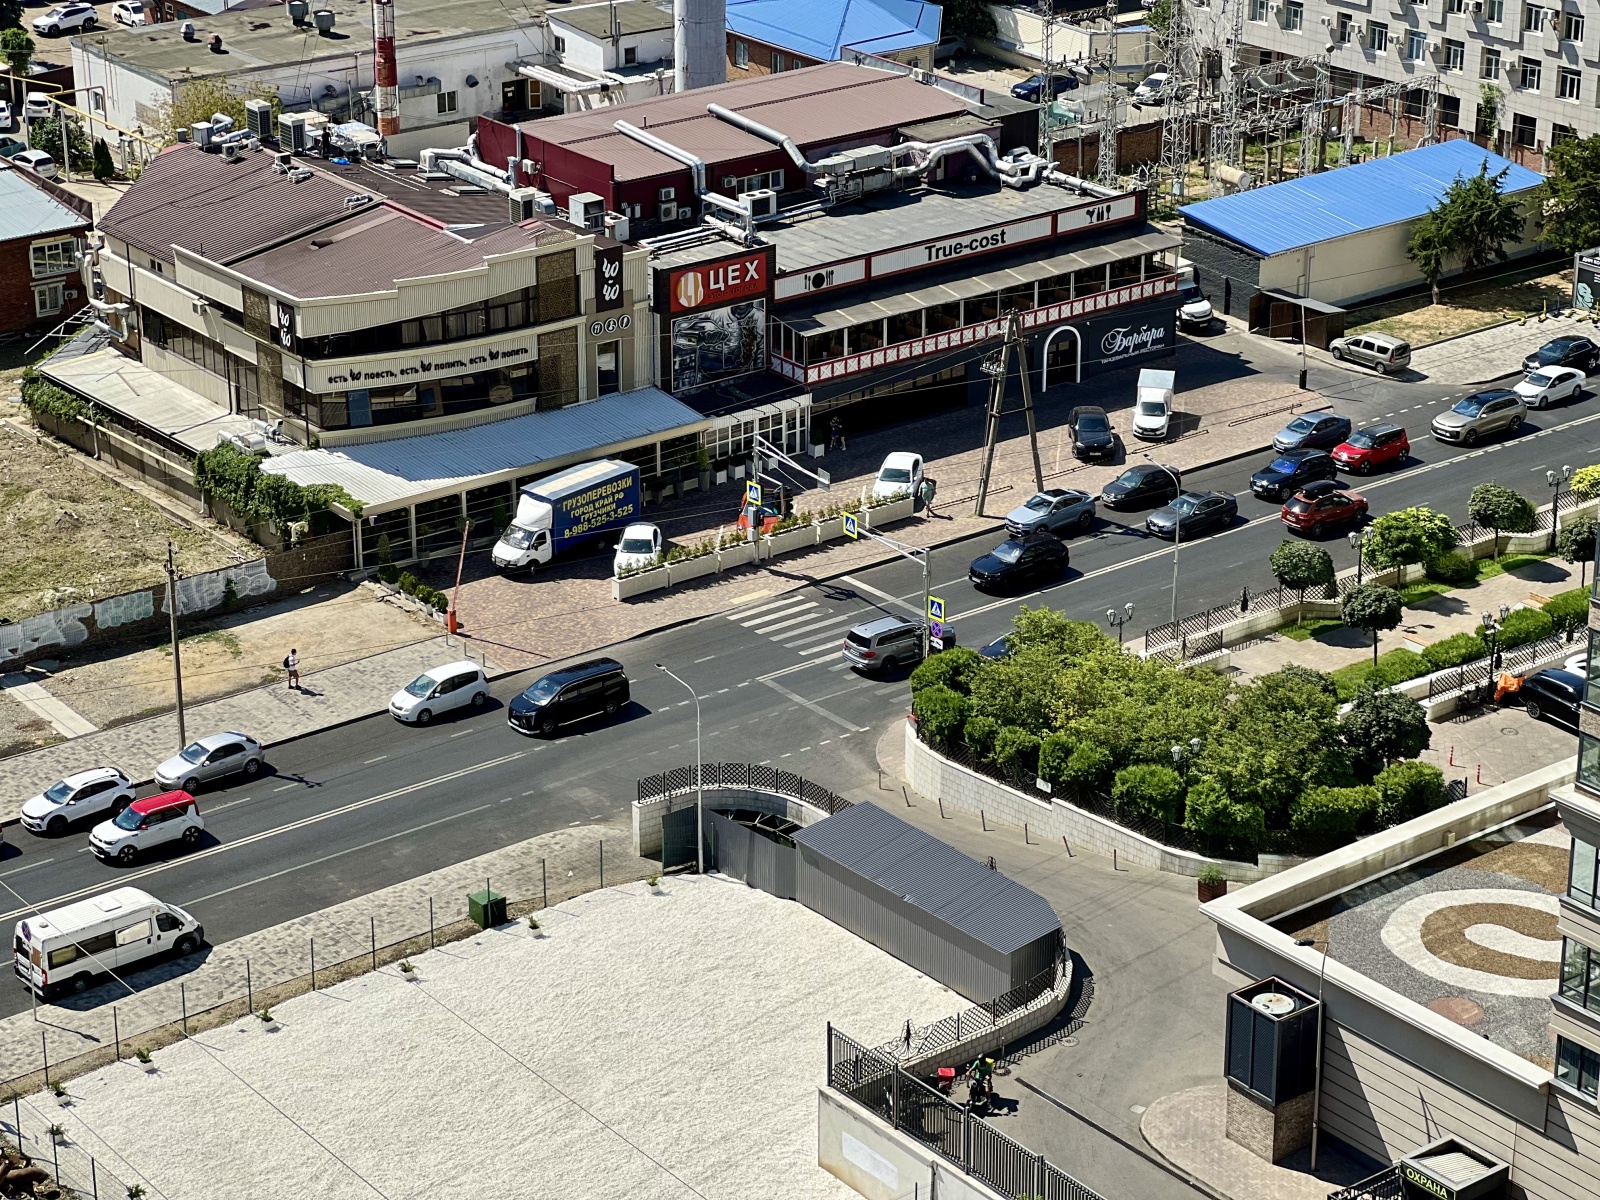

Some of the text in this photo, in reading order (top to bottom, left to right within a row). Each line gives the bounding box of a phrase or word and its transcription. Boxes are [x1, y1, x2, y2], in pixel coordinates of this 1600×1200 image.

[924, 229, 1007, 261] True-cost
[709, 260, 760, 291] ЦЕХ
[708, 290, 729, 300] ЭТОГО
[1101, 324, 1165, 354] Барбара
[328, 374, 348, 384] есть
[364, 370, 397, 381] поесть,
[400, 366, 420, 377] есть
[434, 360, 467, 371] попить,
[469, 355, 488, 365] есть
[501, 347, 529, 359] попеть
[562, 476, 633, 512] ГРУЗОПЕРЕВОЗКИ
[571, 491, 625, 518] ГОРОД КРАЙ РФ
[564, 503, 634, 538] 8-988-525-3-525
[580, 502, 616, 523] ГРУЗЧИКИ
[1406, 1168, 1448, 1199] ОХРАНА
